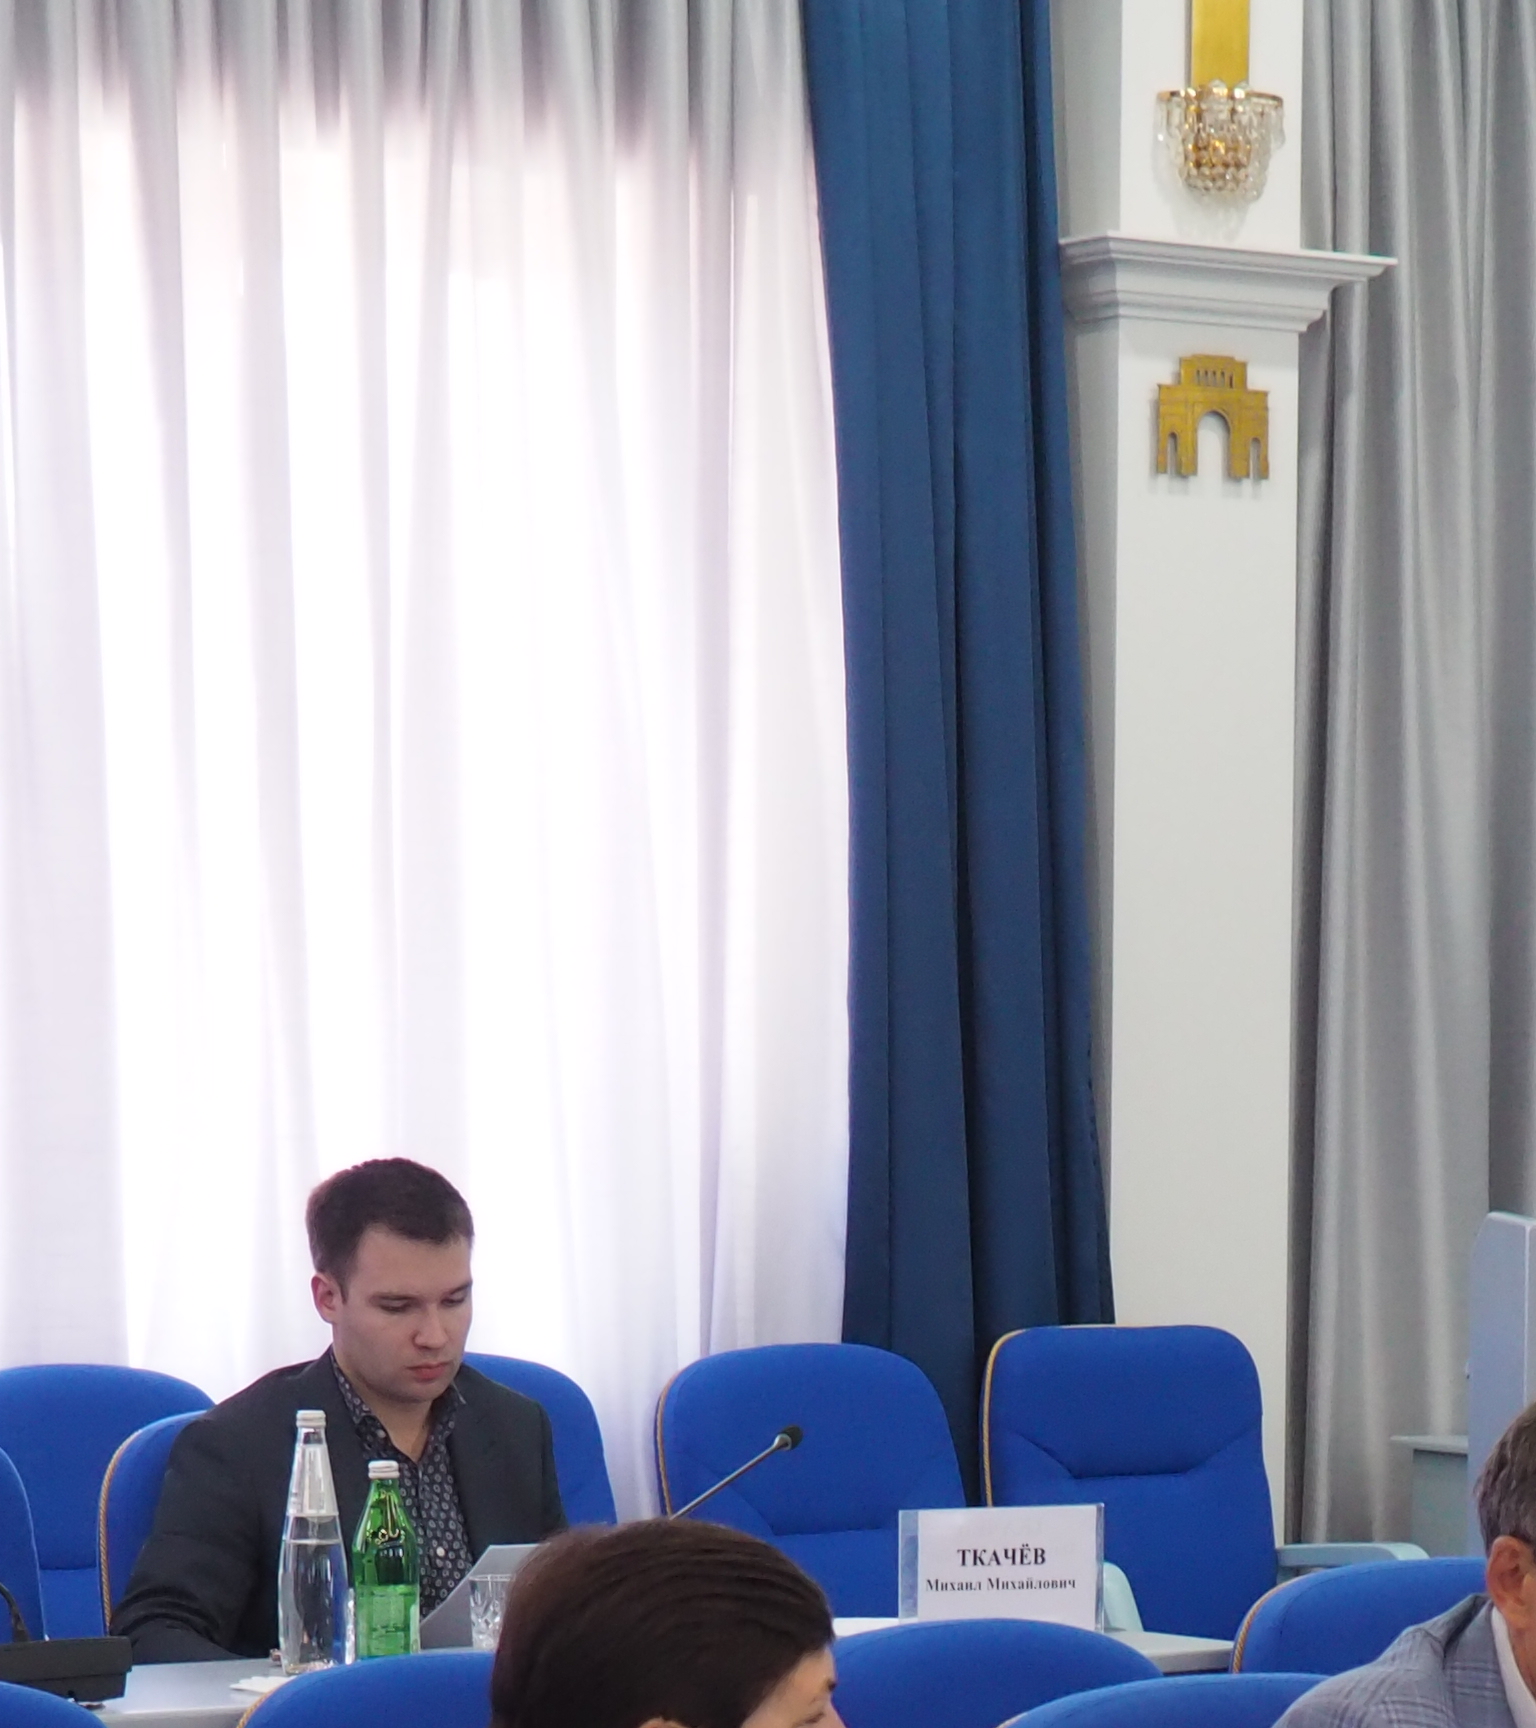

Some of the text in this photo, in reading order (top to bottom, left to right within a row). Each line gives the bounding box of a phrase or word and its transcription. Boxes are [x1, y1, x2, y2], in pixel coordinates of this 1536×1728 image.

[957, 1543, 1047, 1567] ТКАЧЁВ
[925, 1576, 1076, 1592] Михаил Михайлович
